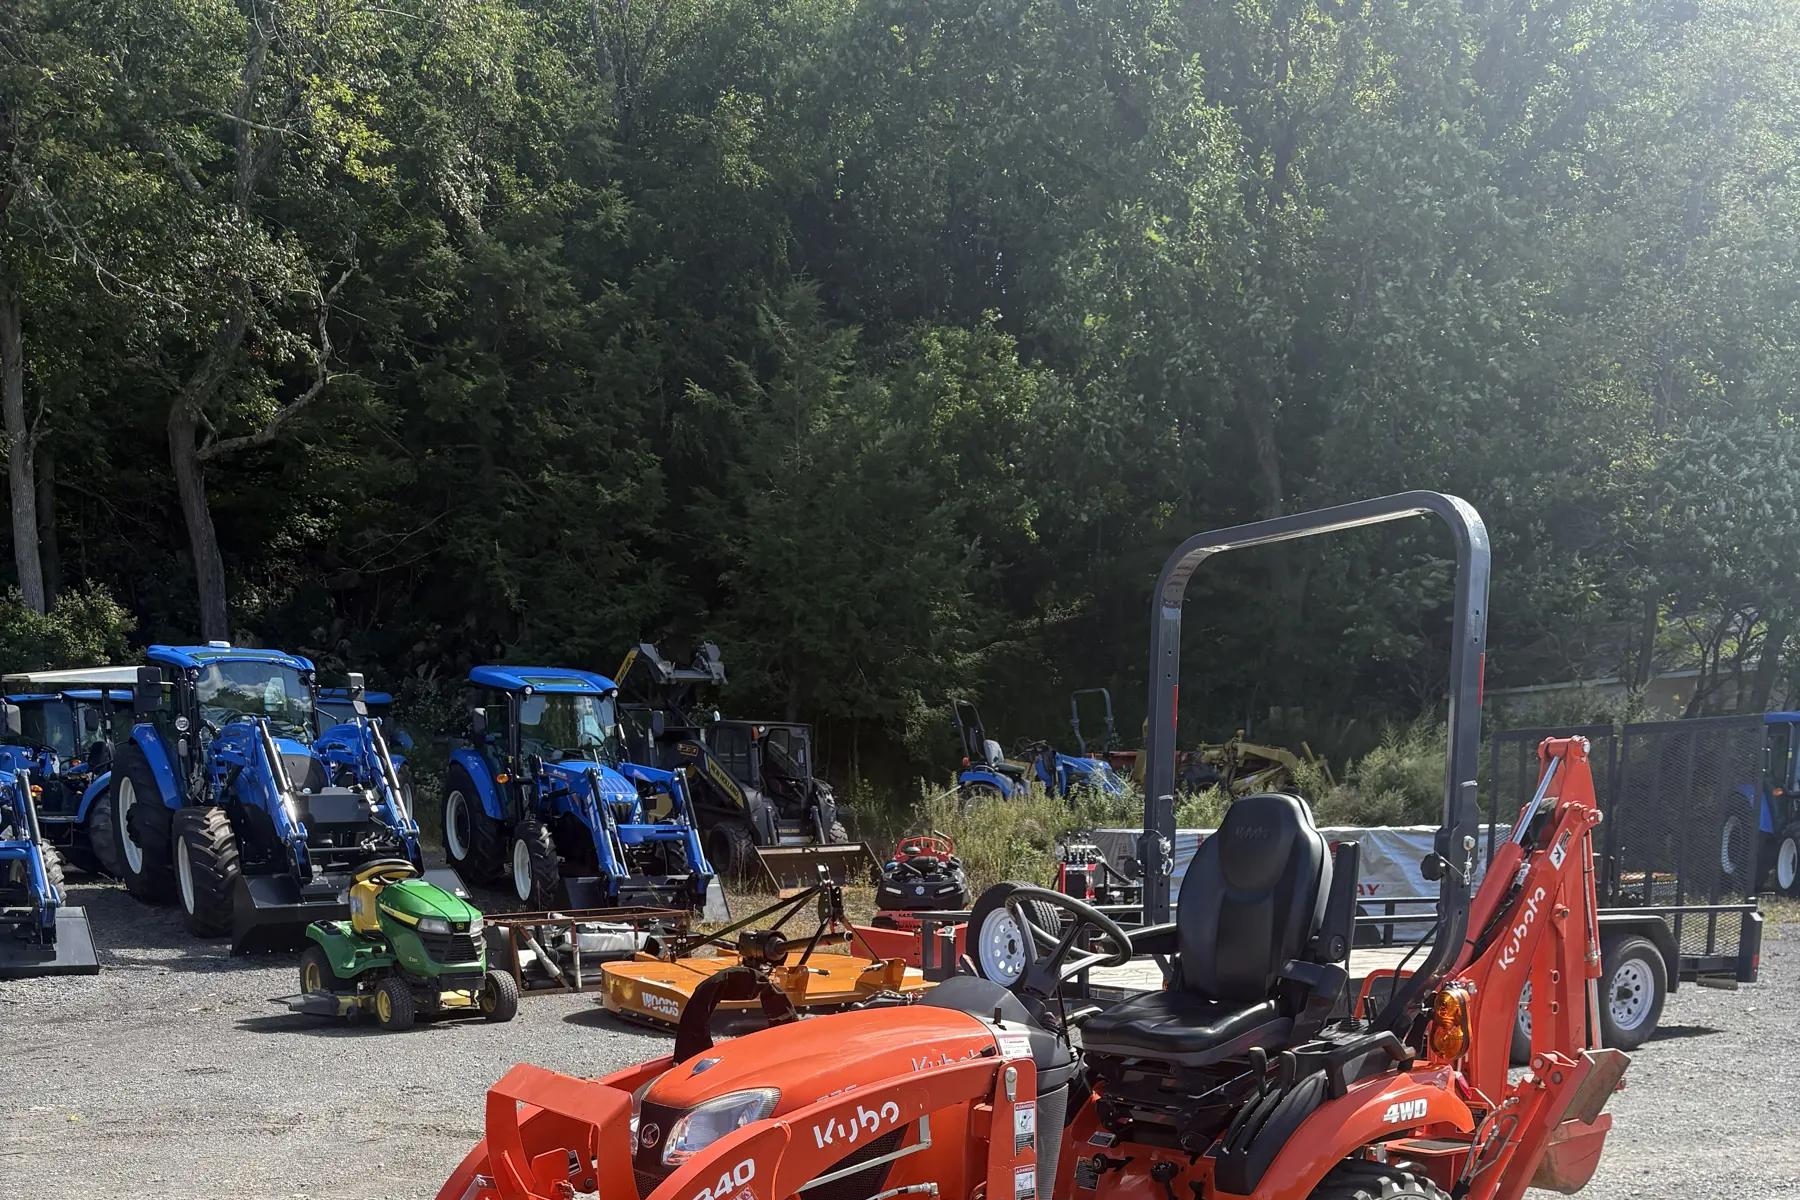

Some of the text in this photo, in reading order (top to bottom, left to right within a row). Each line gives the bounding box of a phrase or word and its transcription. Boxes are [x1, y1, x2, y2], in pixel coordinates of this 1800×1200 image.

[718, 772, 739, 797] HOLLAND
[1498, 886, 1546, 970] Kubota
[641, 991, 679, 1017] WOODS
[1383, 1098, 1428, 1124] 4WD
[813, 1101, 899, 1149] Kubo
